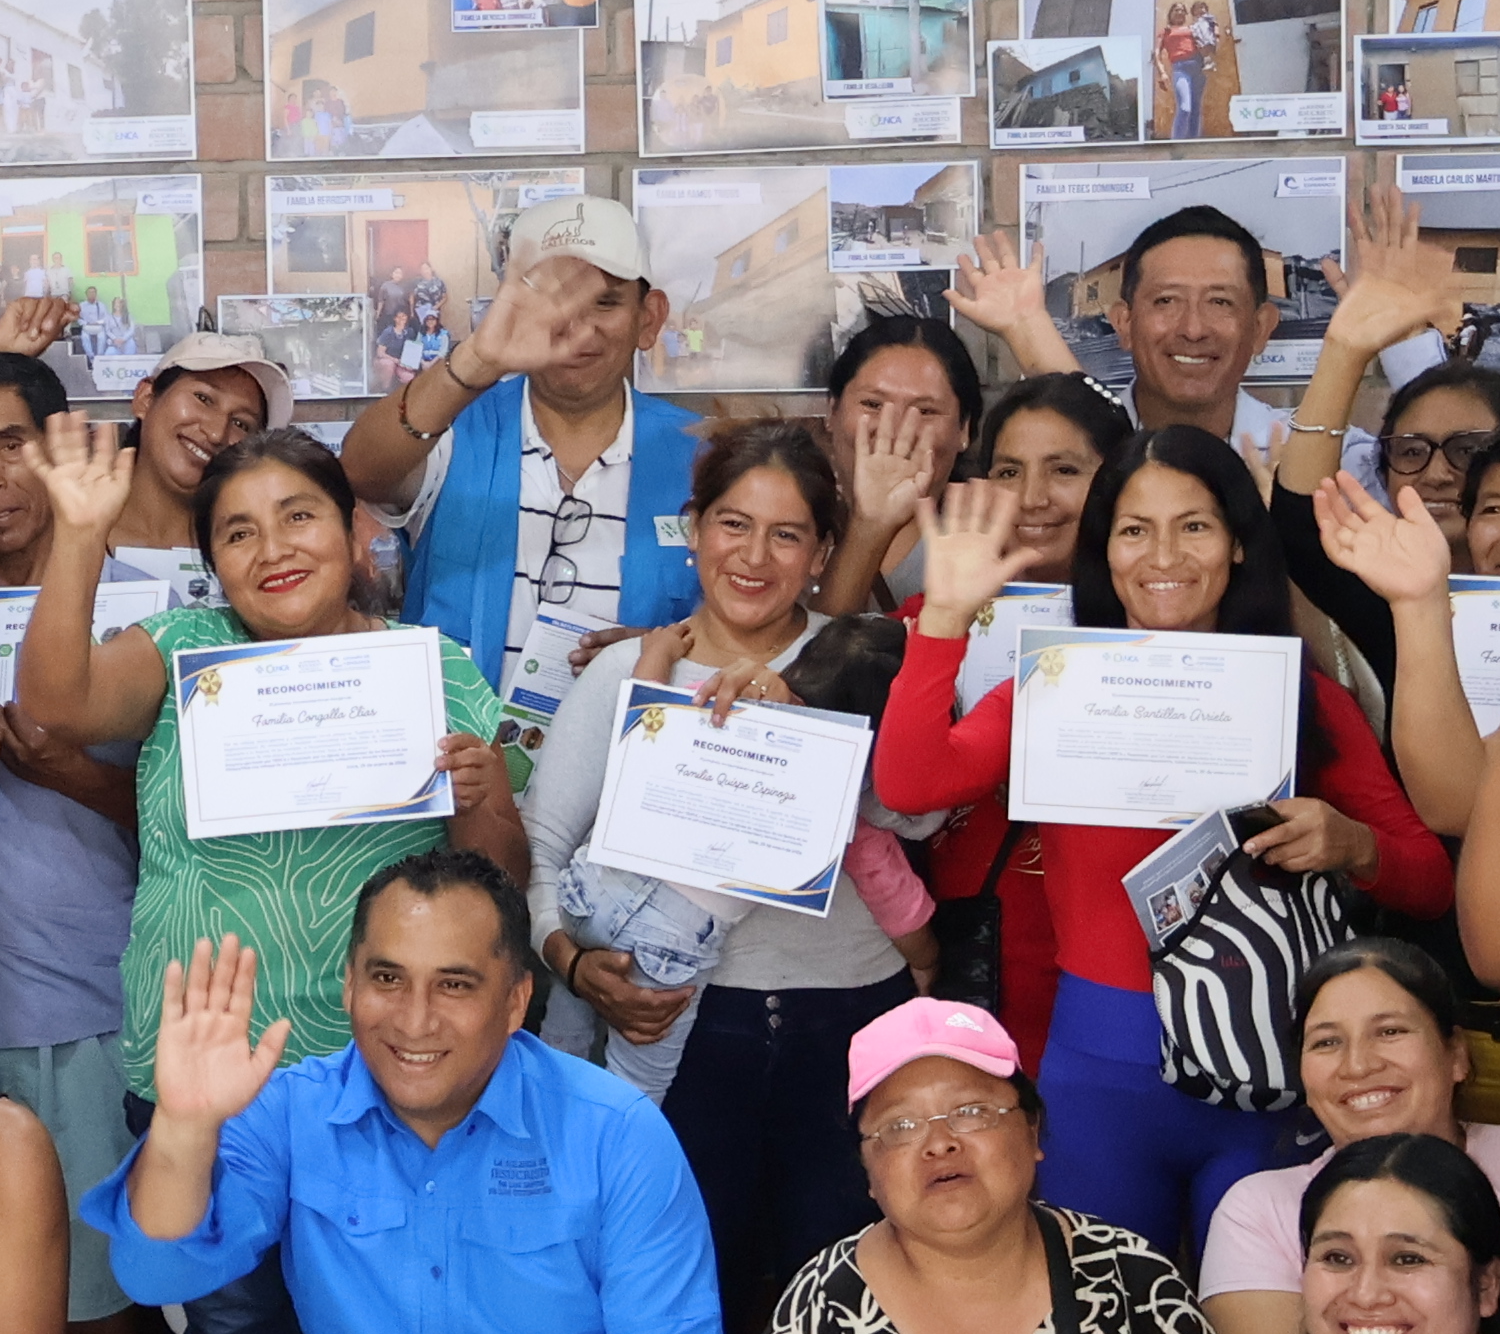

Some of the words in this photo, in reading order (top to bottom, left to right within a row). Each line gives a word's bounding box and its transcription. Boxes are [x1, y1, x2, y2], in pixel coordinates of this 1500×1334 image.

[1412, 175, 1444, 185] MARIELA
[1446, 174, 1474, 184] CARLOS
[1036, 184, 1066, 195] FAMILIA
[286, 196, 315, 206] FAMILIA
[257, 679, 362, 696] RECONOCIMIENTO
[1101, 676, 1213, 689] RECONOCIMIENTO
[252, 712, 294, 728] Familia
[348, 706, 377, 719] Elias
[1084, 703, 1129, 718] Familia
[693, 739, 788, 767] RECONOCIMIENTO
[675, 763, 714, 783] Familia
[716, 773, 750, 791] Quispe
[752, 781, 796, 803] Espinoza
